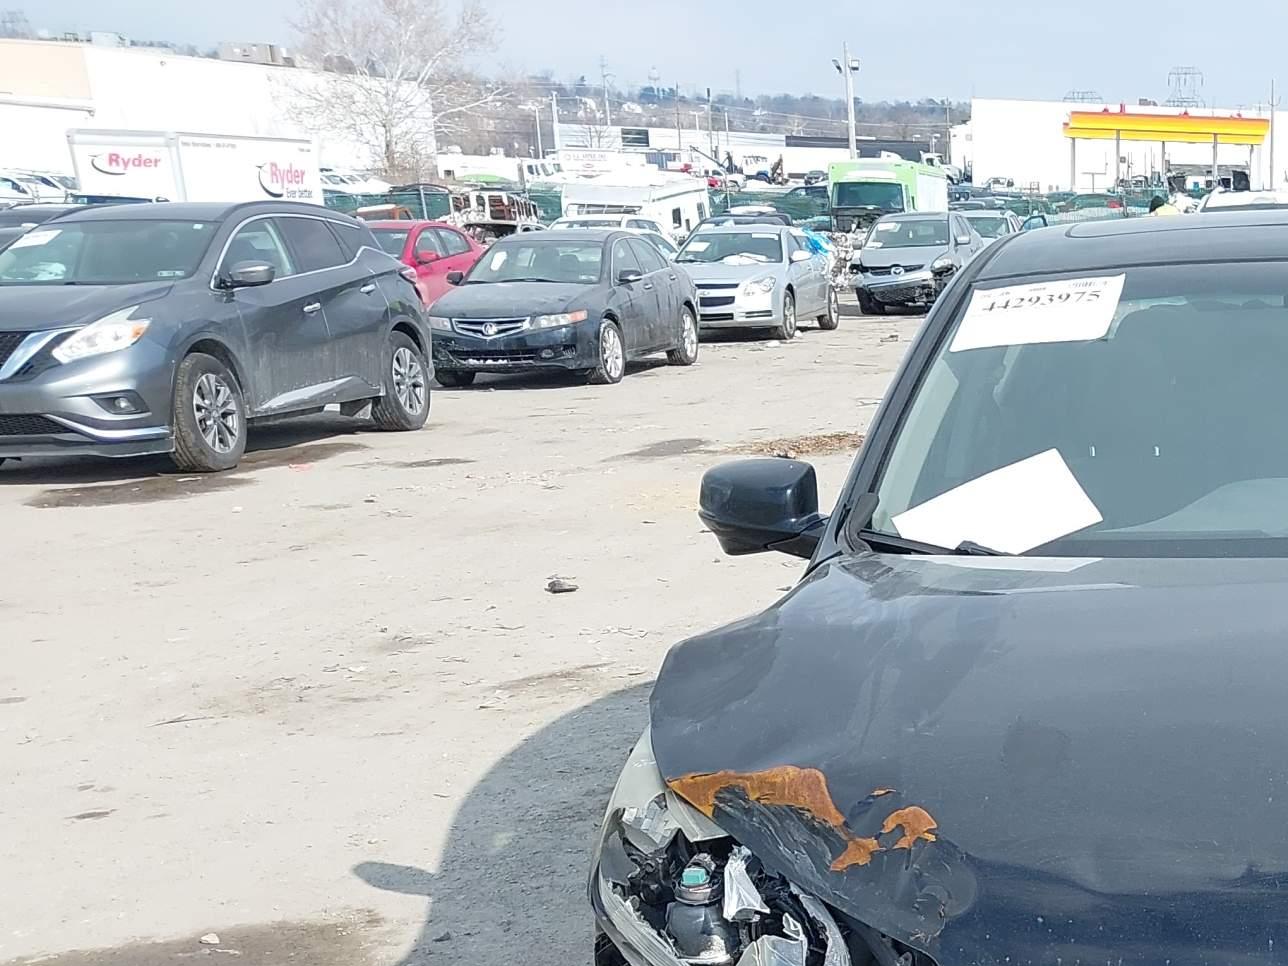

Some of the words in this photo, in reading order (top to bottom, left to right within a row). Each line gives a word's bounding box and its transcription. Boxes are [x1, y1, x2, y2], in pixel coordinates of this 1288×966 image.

[108, 153, 161, 170] Ryder
[269, 162, 305, 189] Ryder
[982, 290, 1101, 312] 44293975
